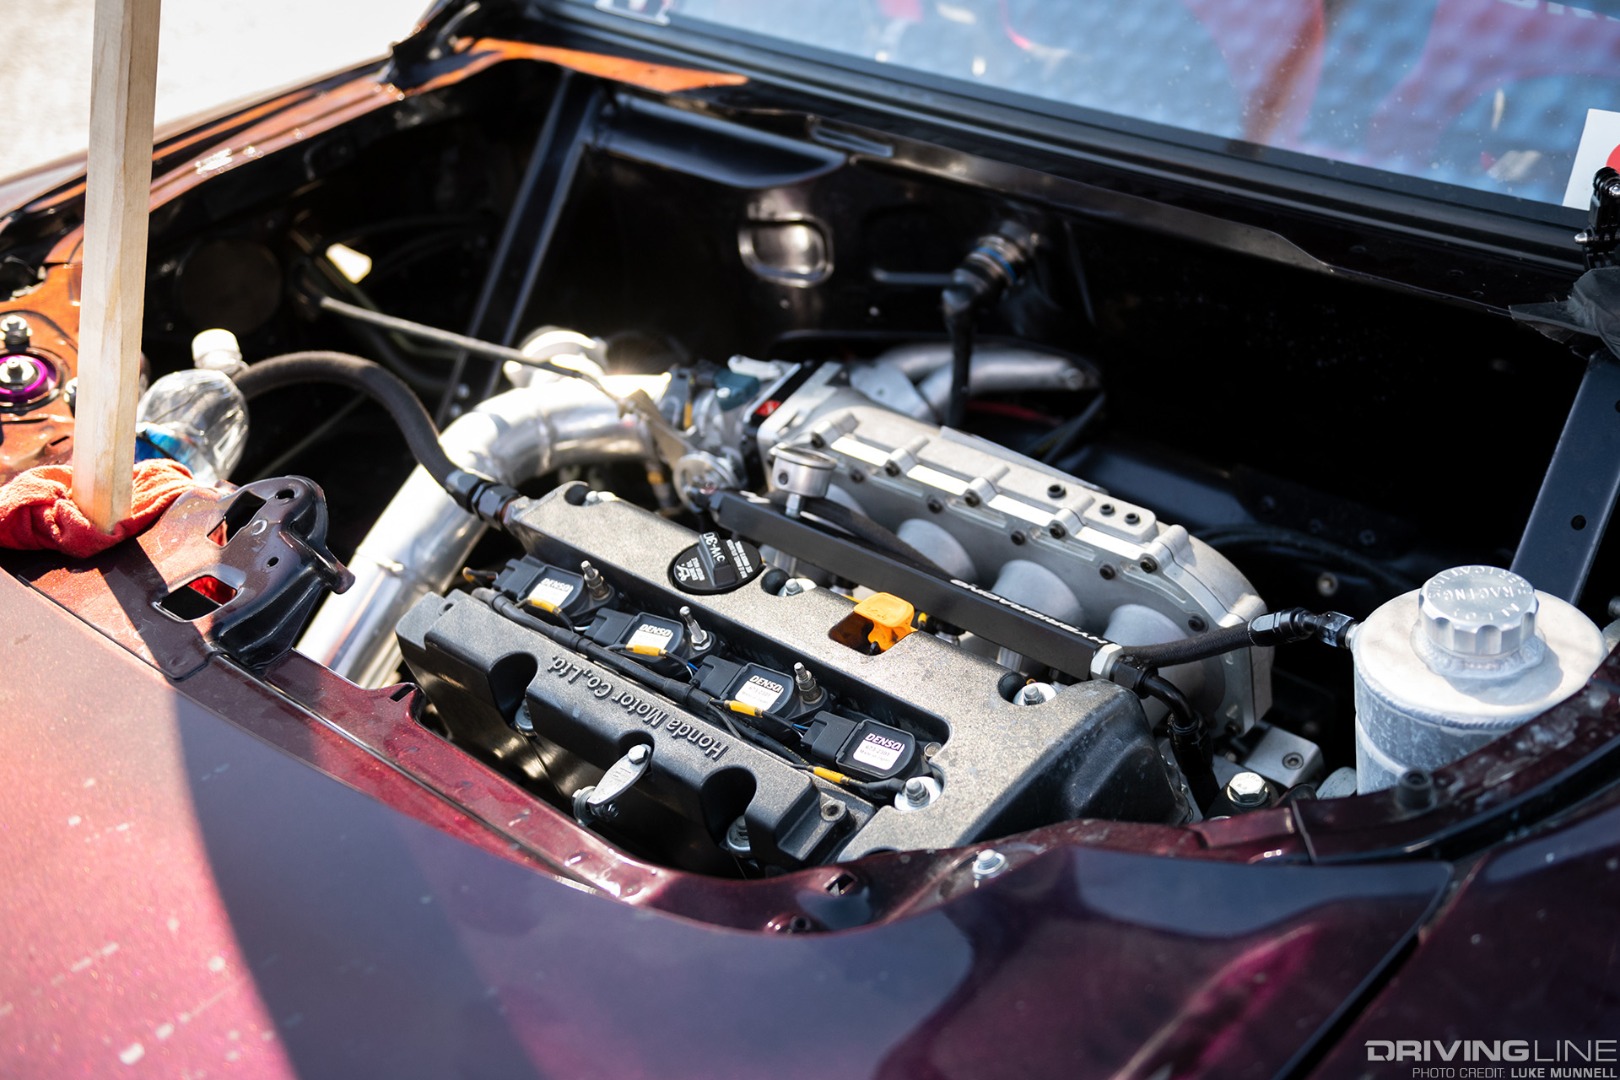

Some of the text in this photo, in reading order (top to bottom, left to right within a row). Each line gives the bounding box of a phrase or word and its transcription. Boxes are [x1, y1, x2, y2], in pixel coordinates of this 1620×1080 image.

[540, 577, 571, 592] DENSO
[1442, 586, 1514, 601] RACING
[638, 623, 671, 638] DENSO
[749, 674, 783, 693] DENSO
[611, 690, 670, 729] Motor
[666, 717, 730, 762] Honda
[865, 732, 902, 752] DENSO
